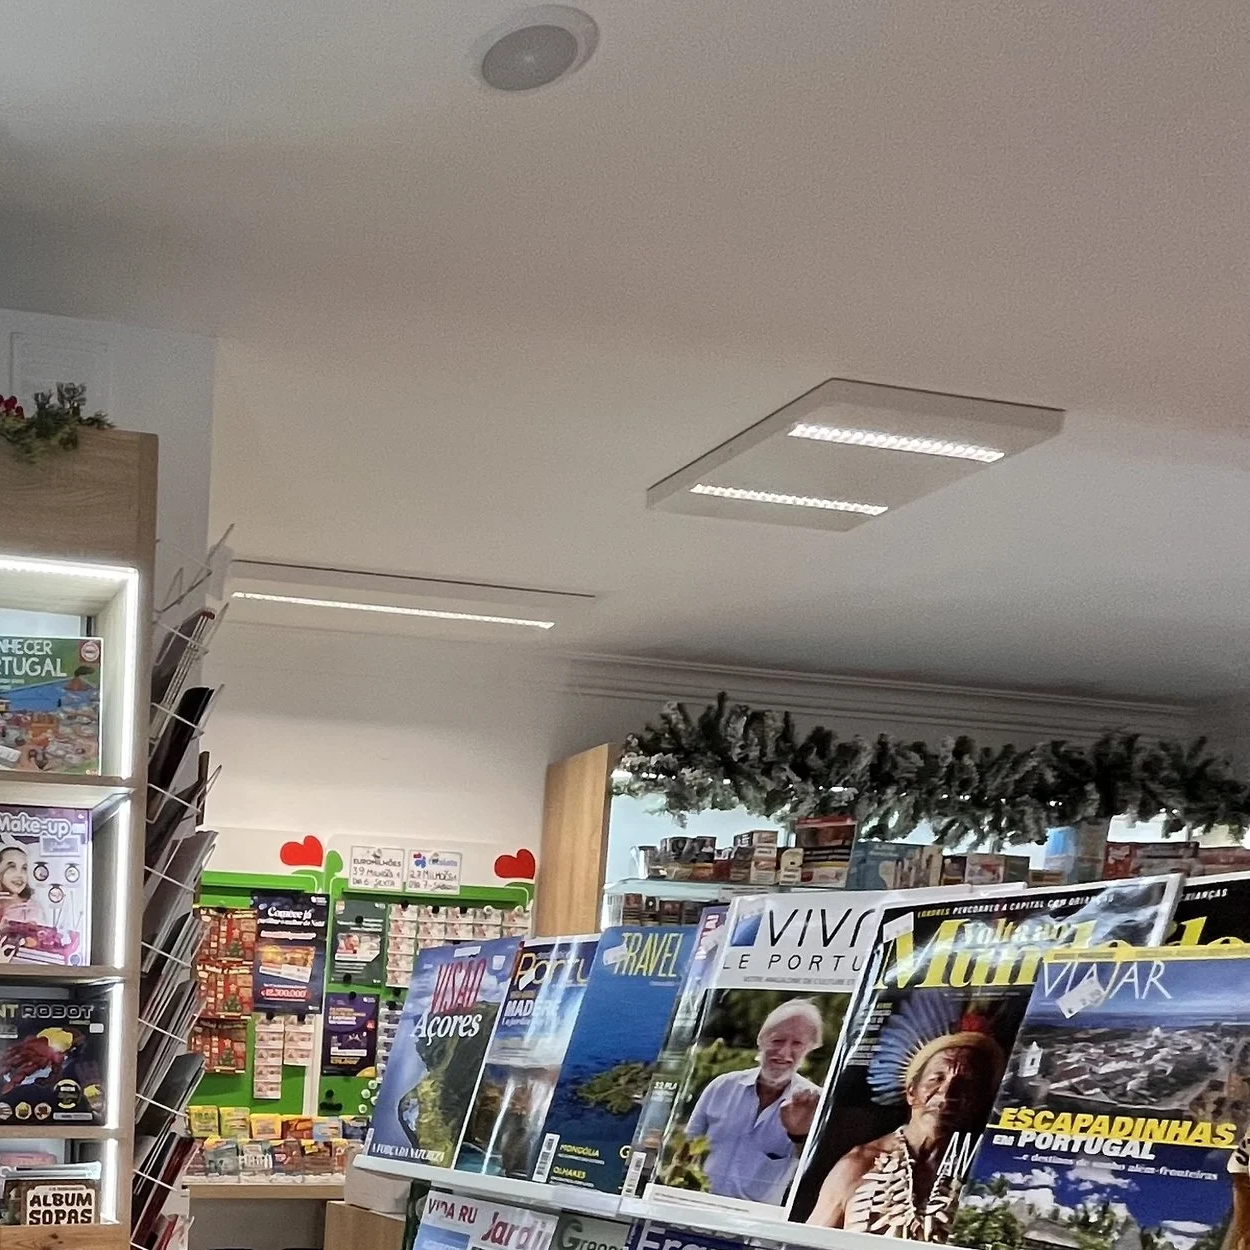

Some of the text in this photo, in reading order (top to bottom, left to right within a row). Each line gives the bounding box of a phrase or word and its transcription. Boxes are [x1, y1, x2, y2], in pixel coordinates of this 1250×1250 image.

[352, 867, 365, 876] 39
[1010, 900, 1045, 911] CAPITAL
[616, 931, 684, 978] TRAVEL
[1043, 960, 1172, 1000] VIAJAR
[21, 1004, 95, 1019] ROBOT
[411, 1012, 483, 1046] Açores
[999, 1106, 1238, 1146] ESCAPADINHAS
[1017, 1130, 1156, 1161] PORTUGAL
[1127, 1163, 1218, 1181] além-fronteiras
[30, 1192, 93, 1207] ALBUM
[29, 1209, 93, 1226] SOPAS
